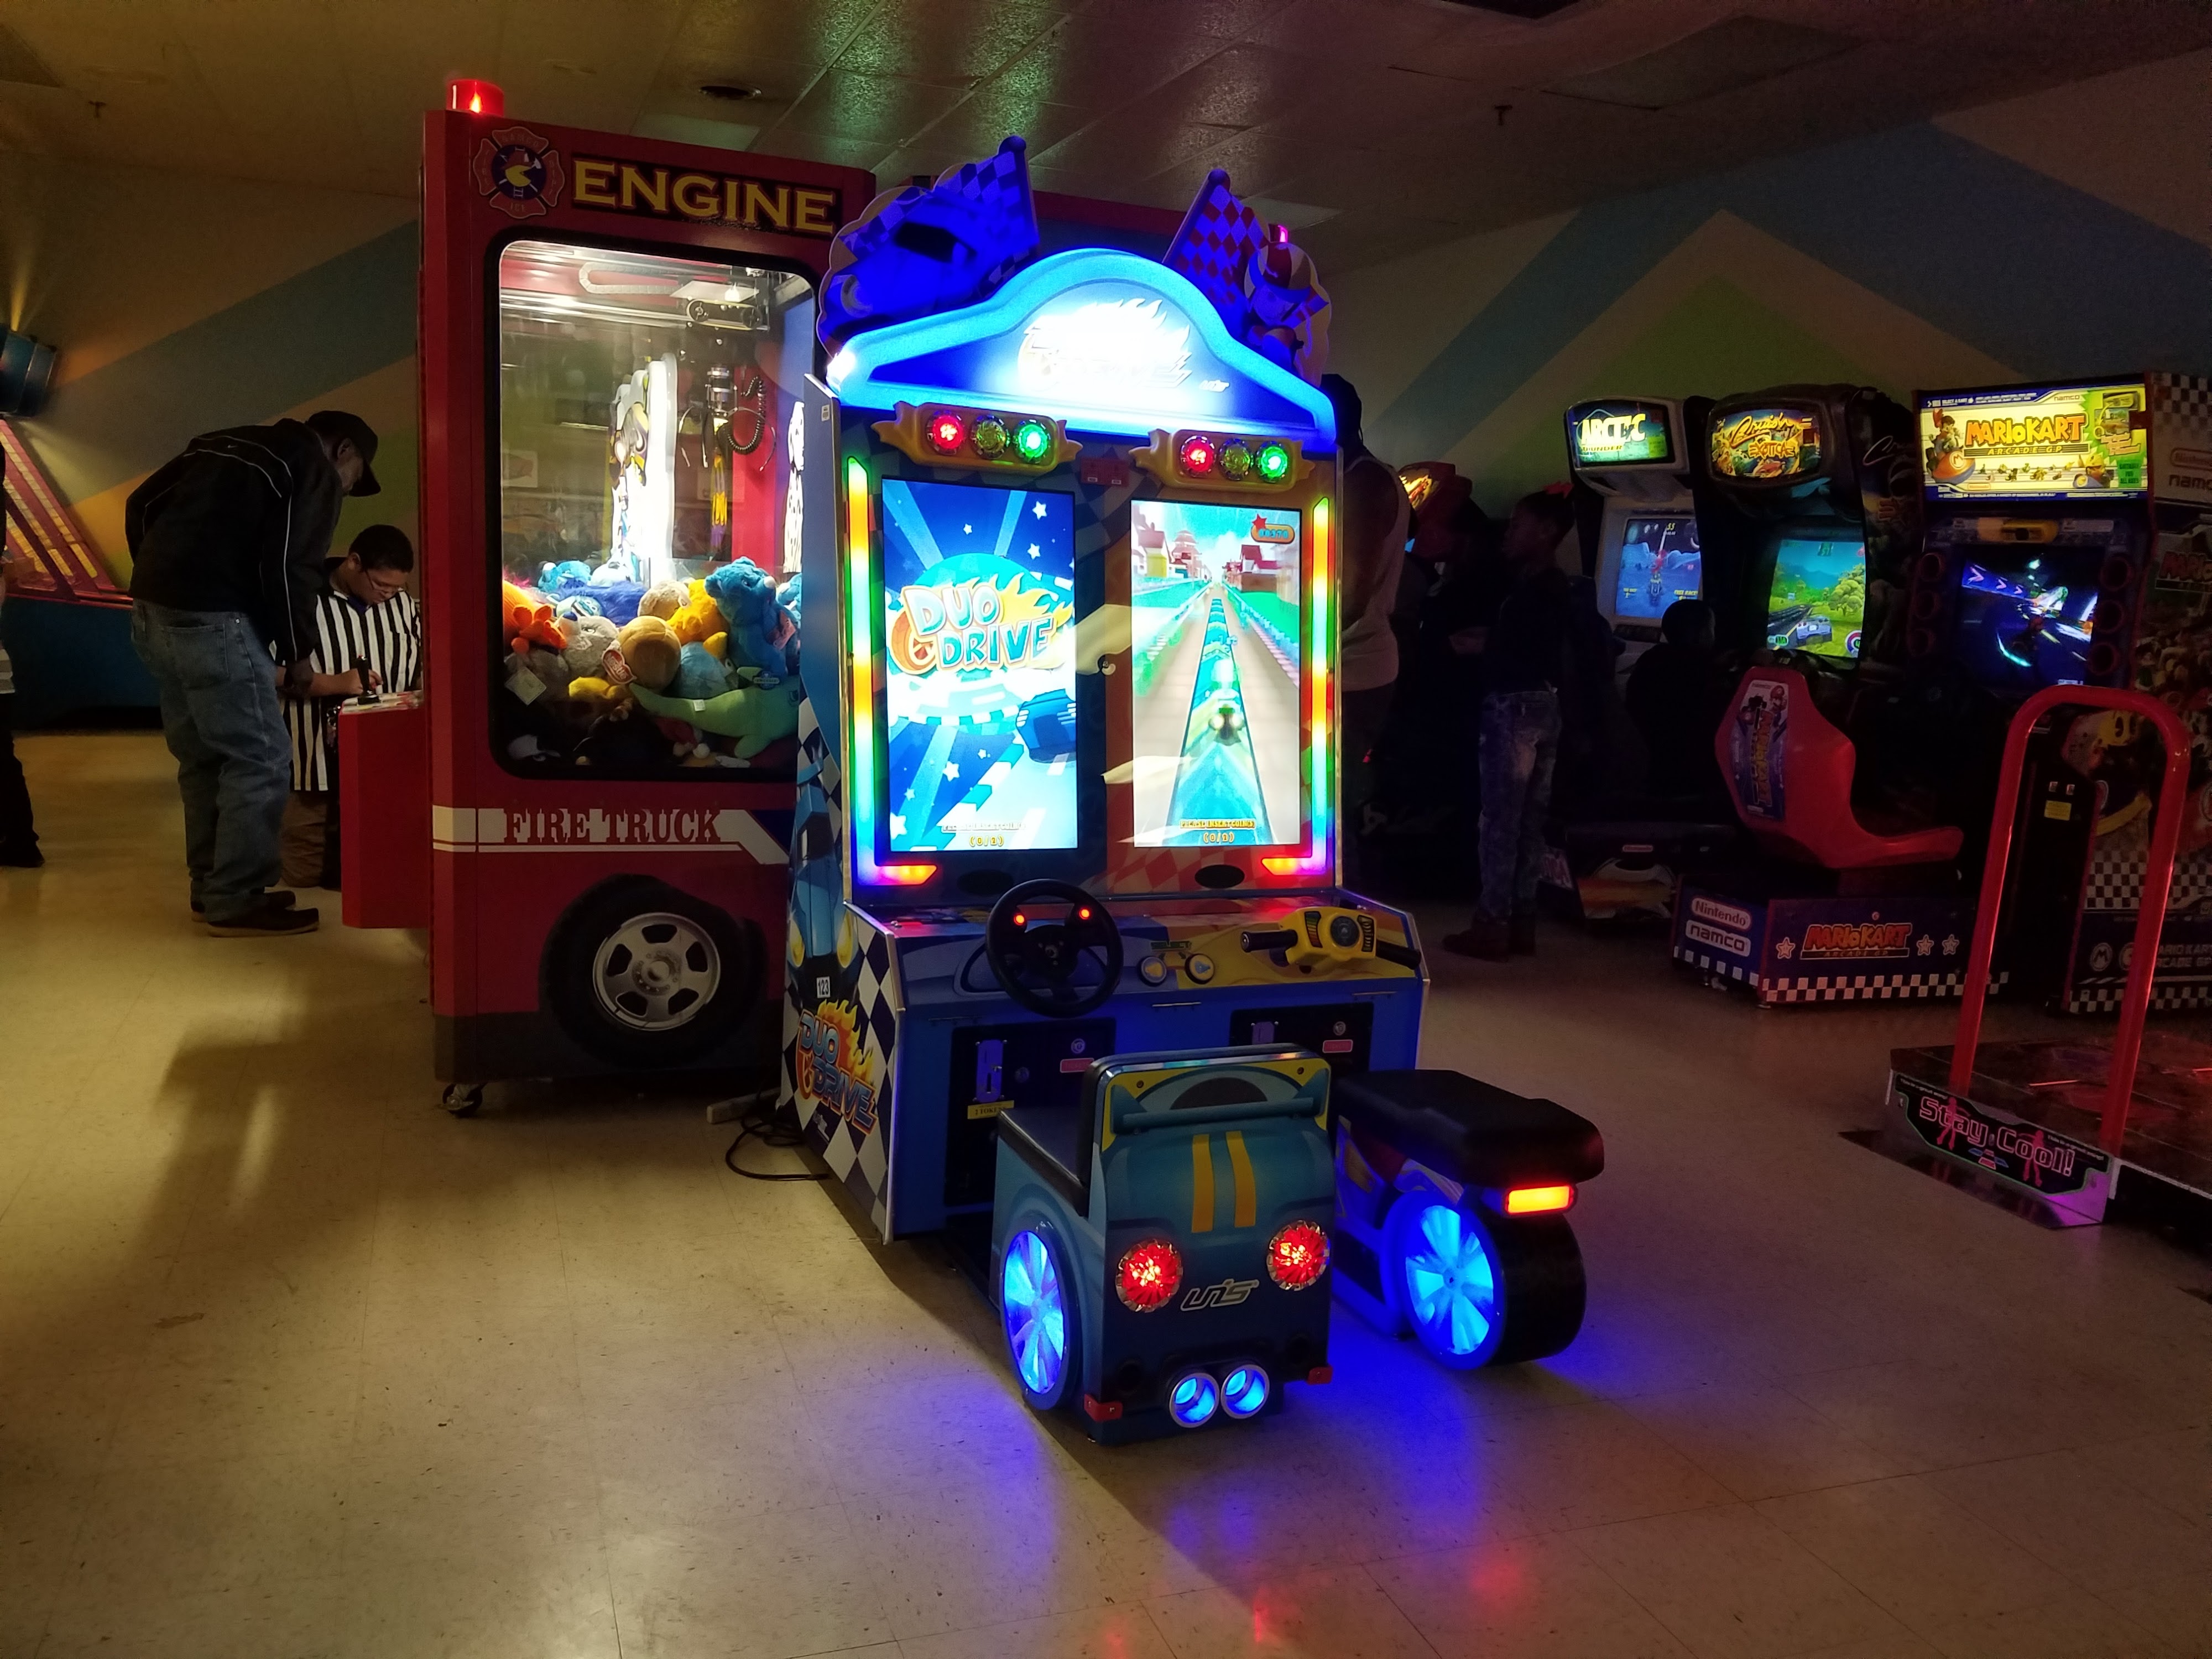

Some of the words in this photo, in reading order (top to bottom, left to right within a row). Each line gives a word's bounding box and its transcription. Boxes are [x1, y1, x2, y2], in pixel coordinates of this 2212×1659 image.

[573, 159, 834, 234] ENGINE
[1581, 413, 1646, 444] ARCTIC
[1730, 412, 1794, 449] Cruis'n
[1749, 441, 1796, 458] EXOTICA
[1987, 446, 2038, 456] ARCADE
[904, 584, 1000, 635] DUO
[941, 617, 1054, 668] DRIVE
[505, 808, 591, 843] FIRE
[603, 808, 722, 843] TRUCK
[1180, 820, 1206, 829] PLEASE
[1206, 820, 1231, 828] INSERT
[1695, 900, 1746, 926] Nintendo
[1690, 924, 1745, 952] namco
[817, 979, 830, 996] 123
[801, 1011, 839, 1064] DUO
[812, 1057, 876, 1130] DRIVE
[1919, 1095, 1989, 1148] Stay
[1996, 1126, 2076, 1177] Cool!
